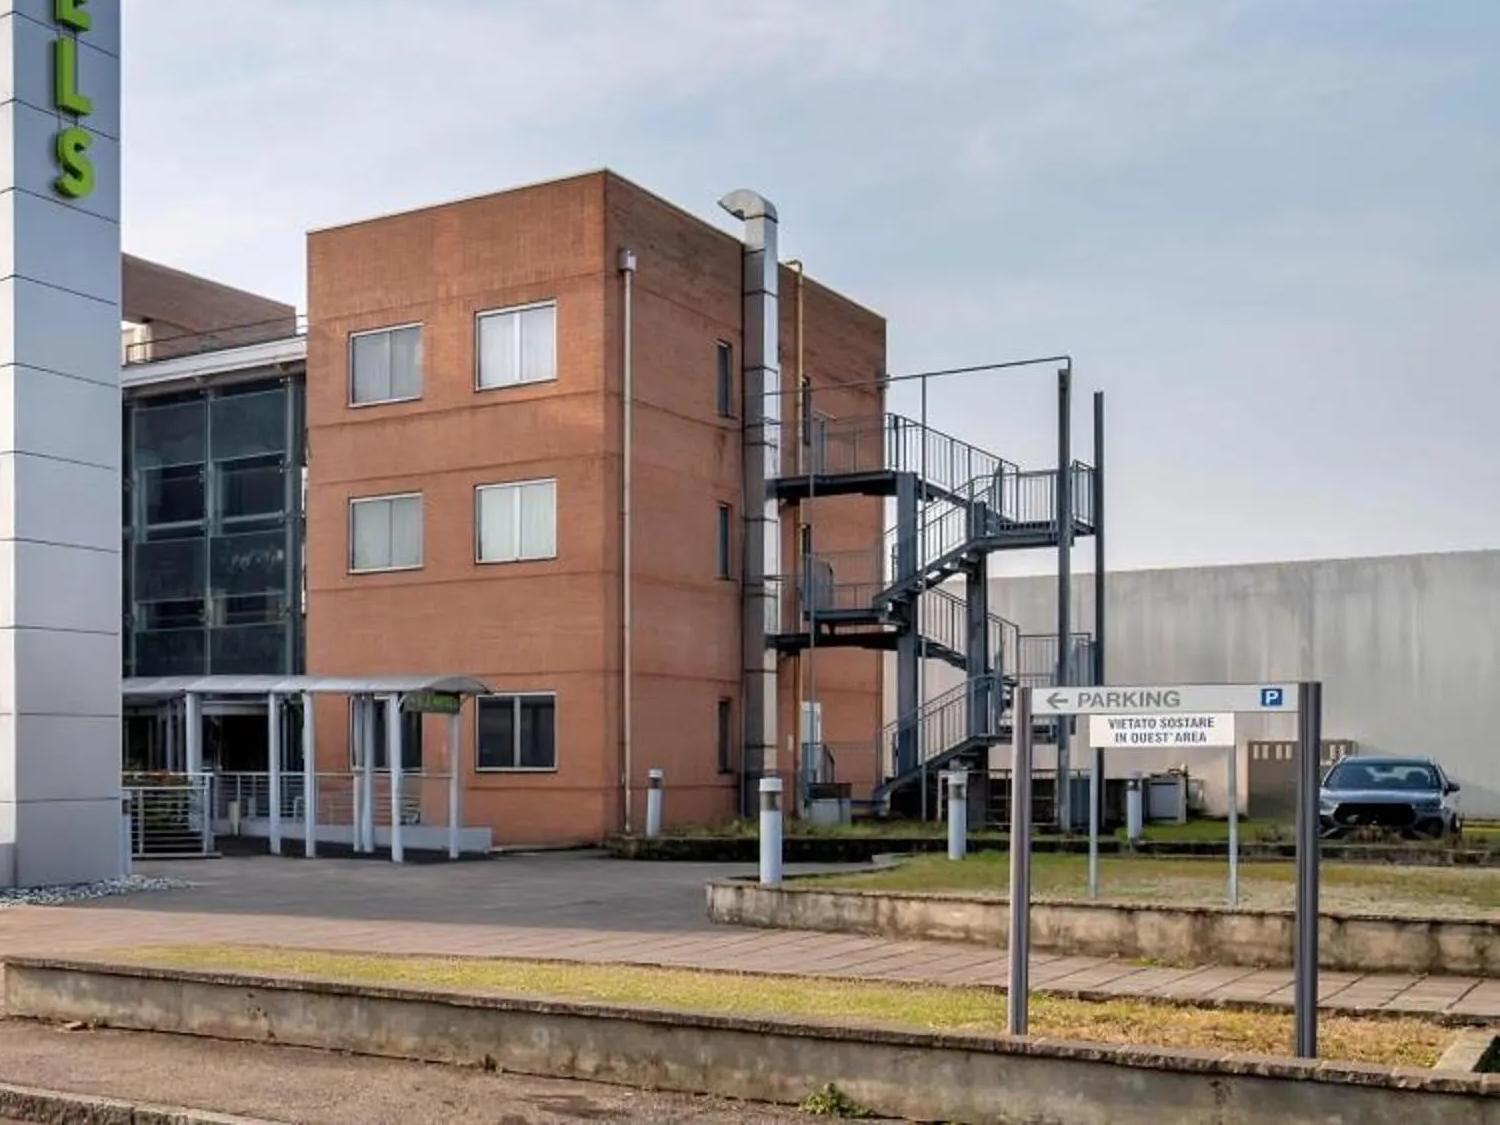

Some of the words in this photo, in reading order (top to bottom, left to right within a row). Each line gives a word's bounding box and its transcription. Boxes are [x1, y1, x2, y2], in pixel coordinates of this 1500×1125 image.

[1077, 690, 1181, 708] PARKING
[1266, 690, 1279, 705] P
[1108, 718, 1157, 730] VIETATO
[1159, 716, 1215, 729] SOSTARE
[1115, 732, 1128, 744] IN
